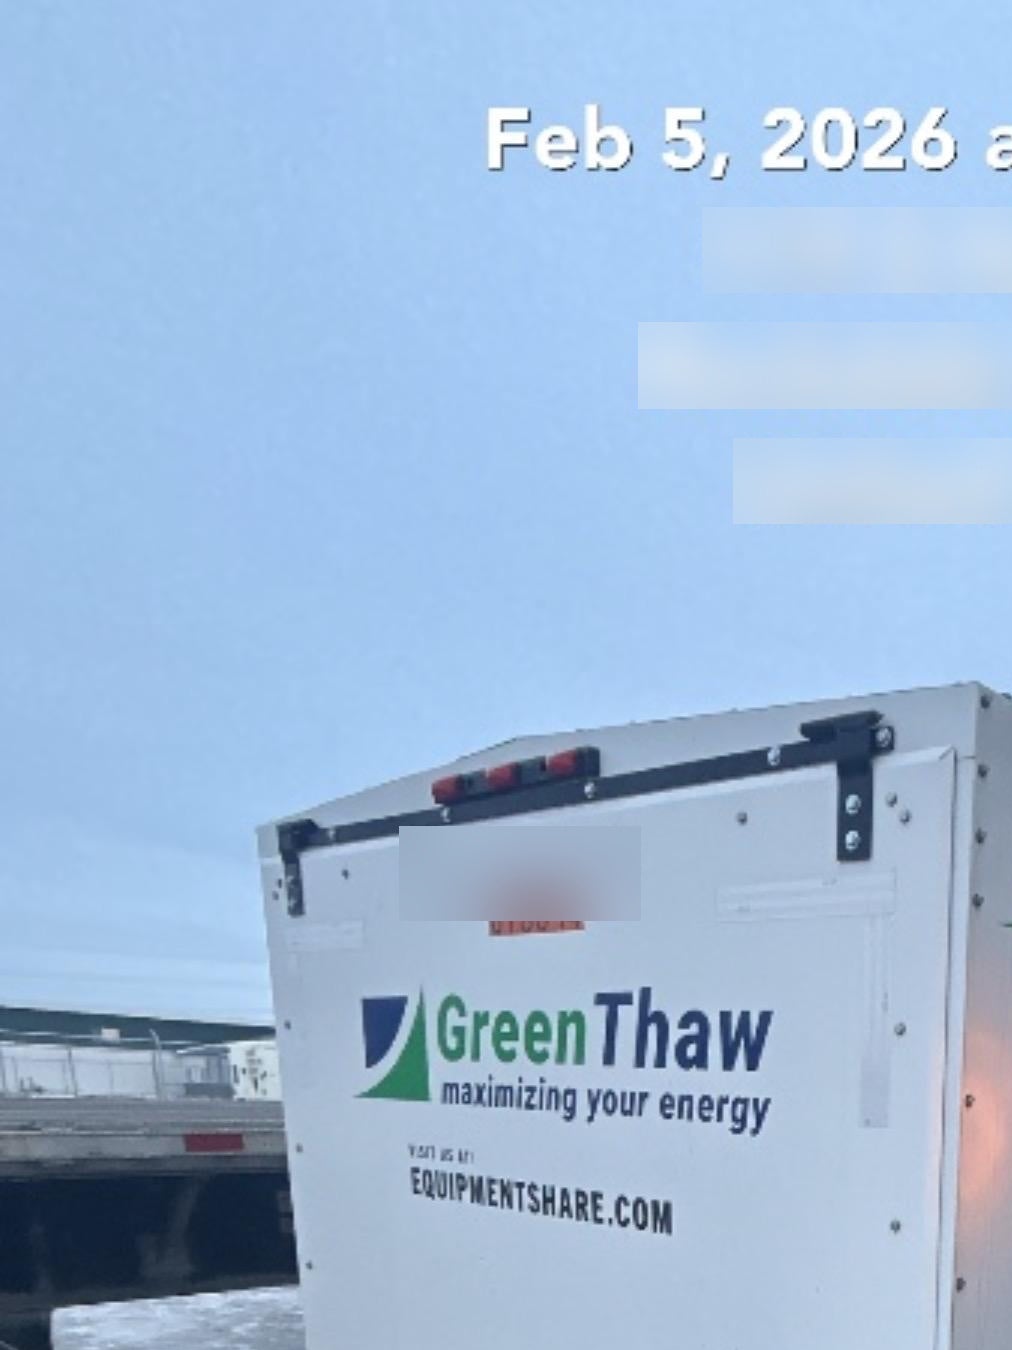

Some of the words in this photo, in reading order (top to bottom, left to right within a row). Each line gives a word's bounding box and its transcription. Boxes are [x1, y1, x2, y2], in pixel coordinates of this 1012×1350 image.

[436, 986, 774, 1073] GreenThaw
[441, 1075, 578, 1121] maximizing
[586, 1090, 649, 1124] your
[658, 1092, 772, 1137] energy
[410, 1166, 674, 1237] EQUIPMENTSHARE.COM
